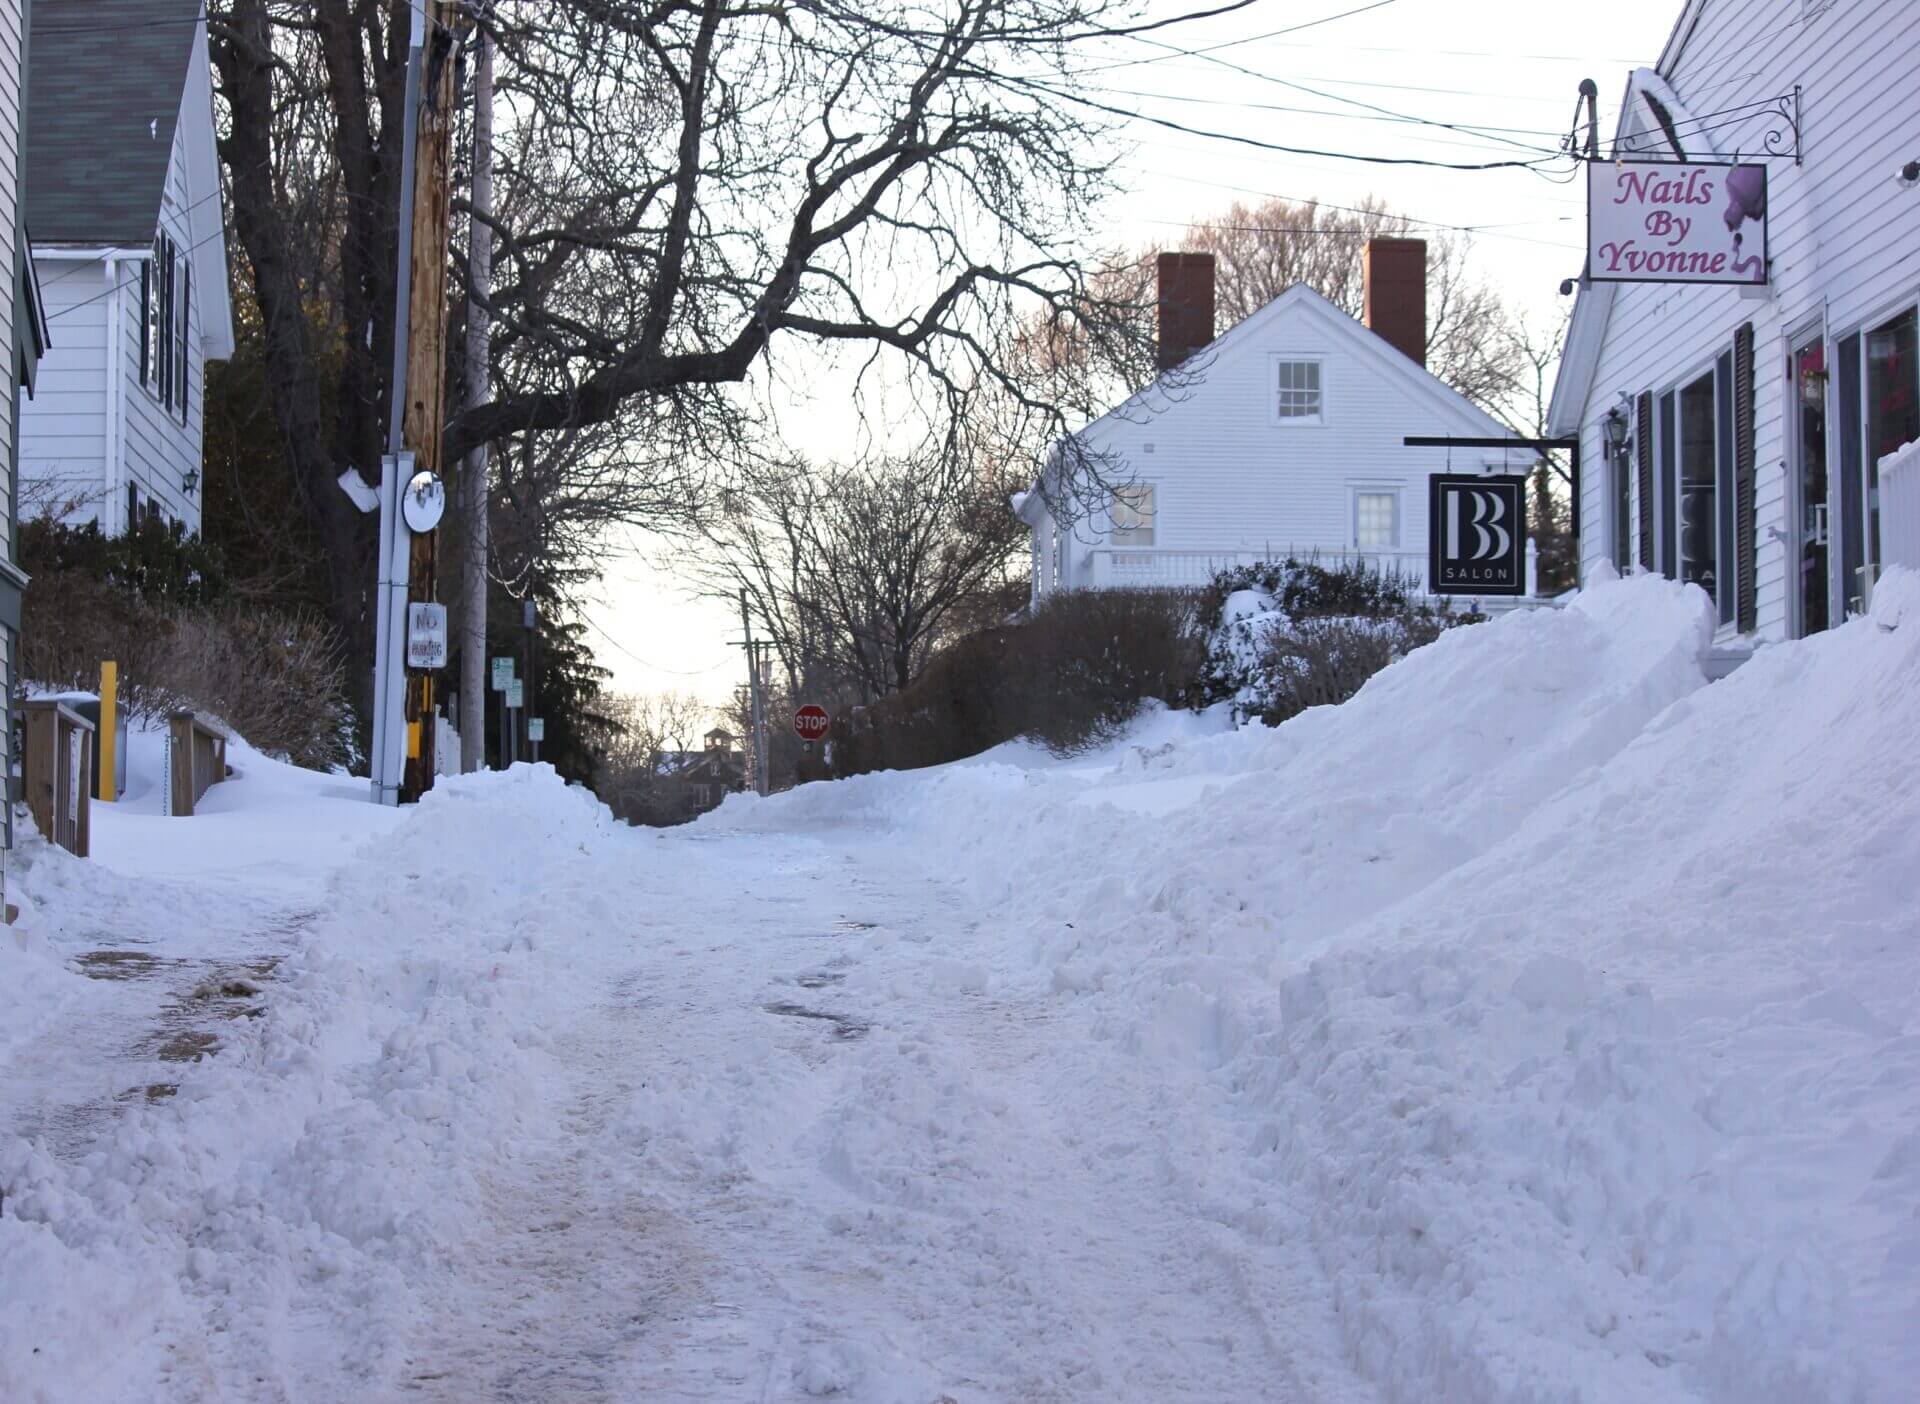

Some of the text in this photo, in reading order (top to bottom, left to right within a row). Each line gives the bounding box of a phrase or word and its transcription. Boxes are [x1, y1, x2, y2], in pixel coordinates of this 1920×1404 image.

[1613, 168, 1714, 205] Nails
[1645, 210, 1691, 246] By
[1598, 240, 1727, 274] Yvonne
[1446, 567, 1508, 579] SALON
[416, 613, 437, 630] NO
[795, 715, 827, 730] STOP
